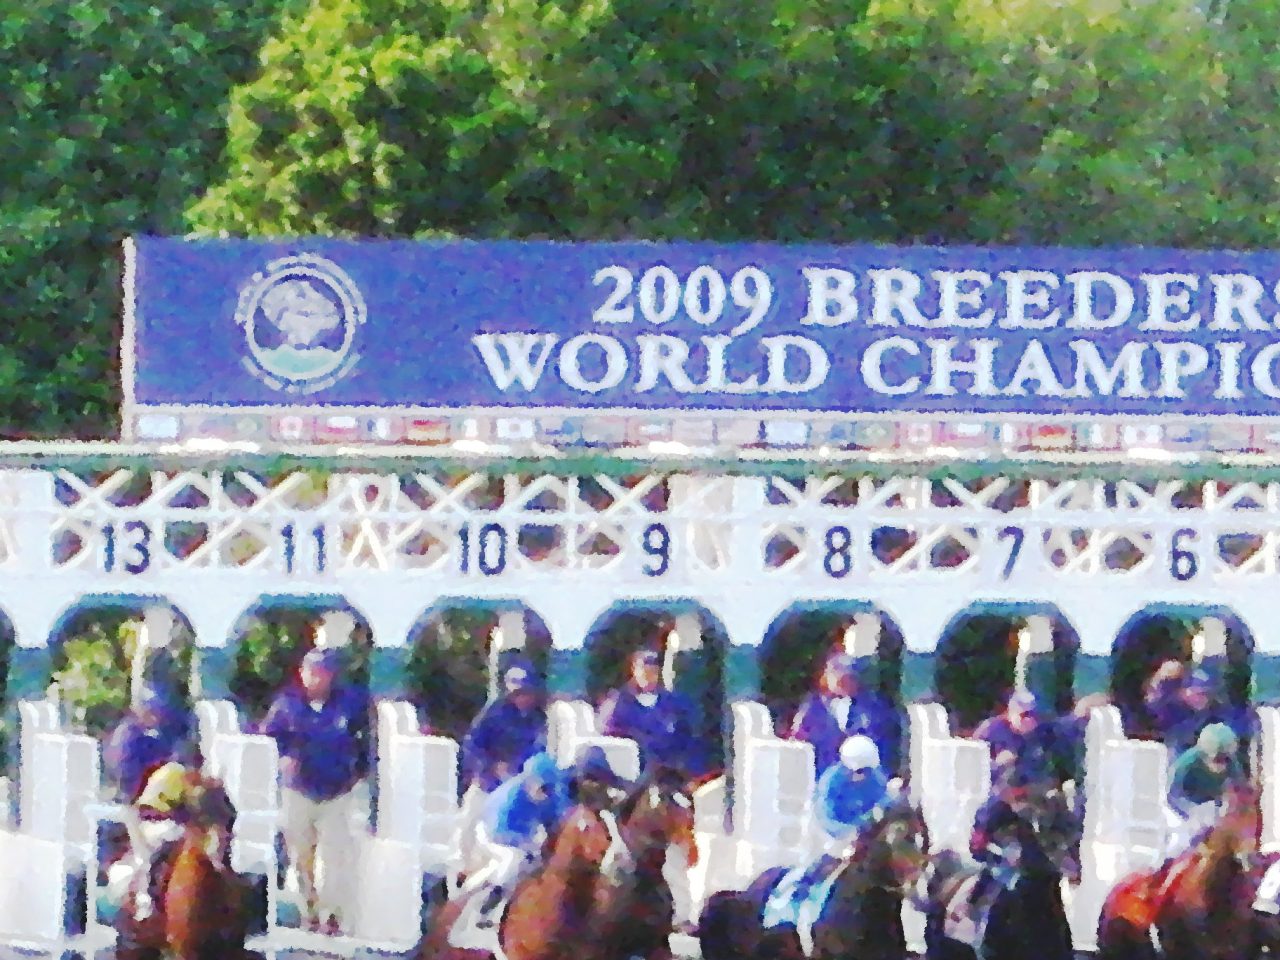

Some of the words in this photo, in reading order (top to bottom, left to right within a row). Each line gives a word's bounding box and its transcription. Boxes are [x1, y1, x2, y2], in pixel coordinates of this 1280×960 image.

[592, 264, 773, 337] 2009
[472, 331, 829, 394] WORLD
[102, 519, 151, 574] 13
[281, 522, 327, 573] 11
[458, 521, 508, 576] 10
[641, 522, 670, 577] 9
[823, 525, 852, 579] 8
[999, 525, 1025, 580] 7
[1169, 527, 1198, 581] 6
